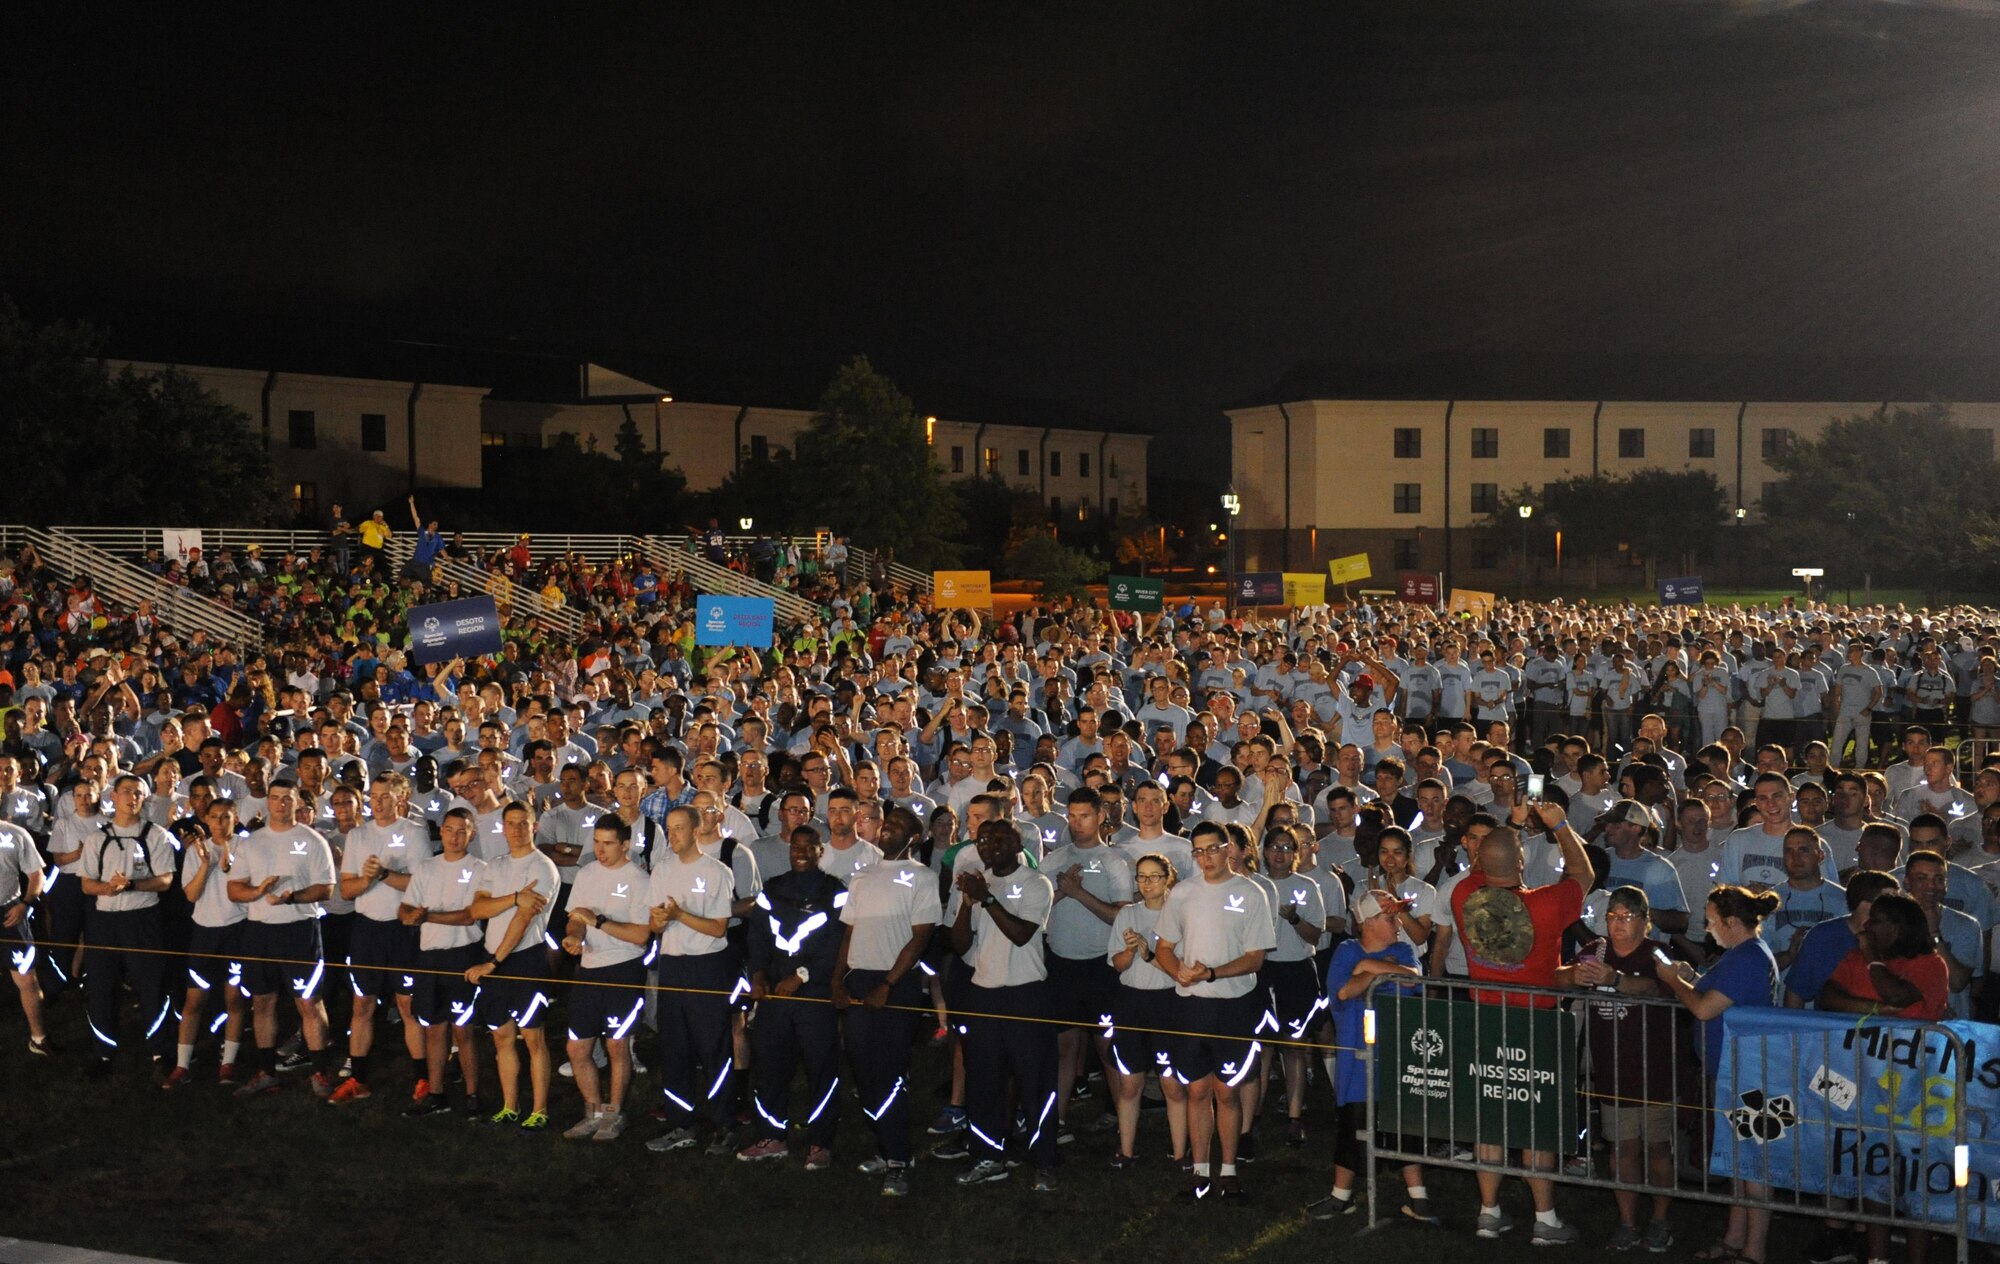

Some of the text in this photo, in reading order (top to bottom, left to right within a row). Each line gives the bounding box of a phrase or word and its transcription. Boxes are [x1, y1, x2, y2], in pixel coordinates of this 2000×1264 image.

[455, 616, 484, 627] DESOTO
[458, 624, 485, 635] REGION
[1496, 1046, 1526, 1062] MID
[1468, 1062, 1555, 1085] MISSSSIPPI
[1409, 1086, 1448, 1099] Missssippi
[1482, 1083, 1541, 1104] REGION
